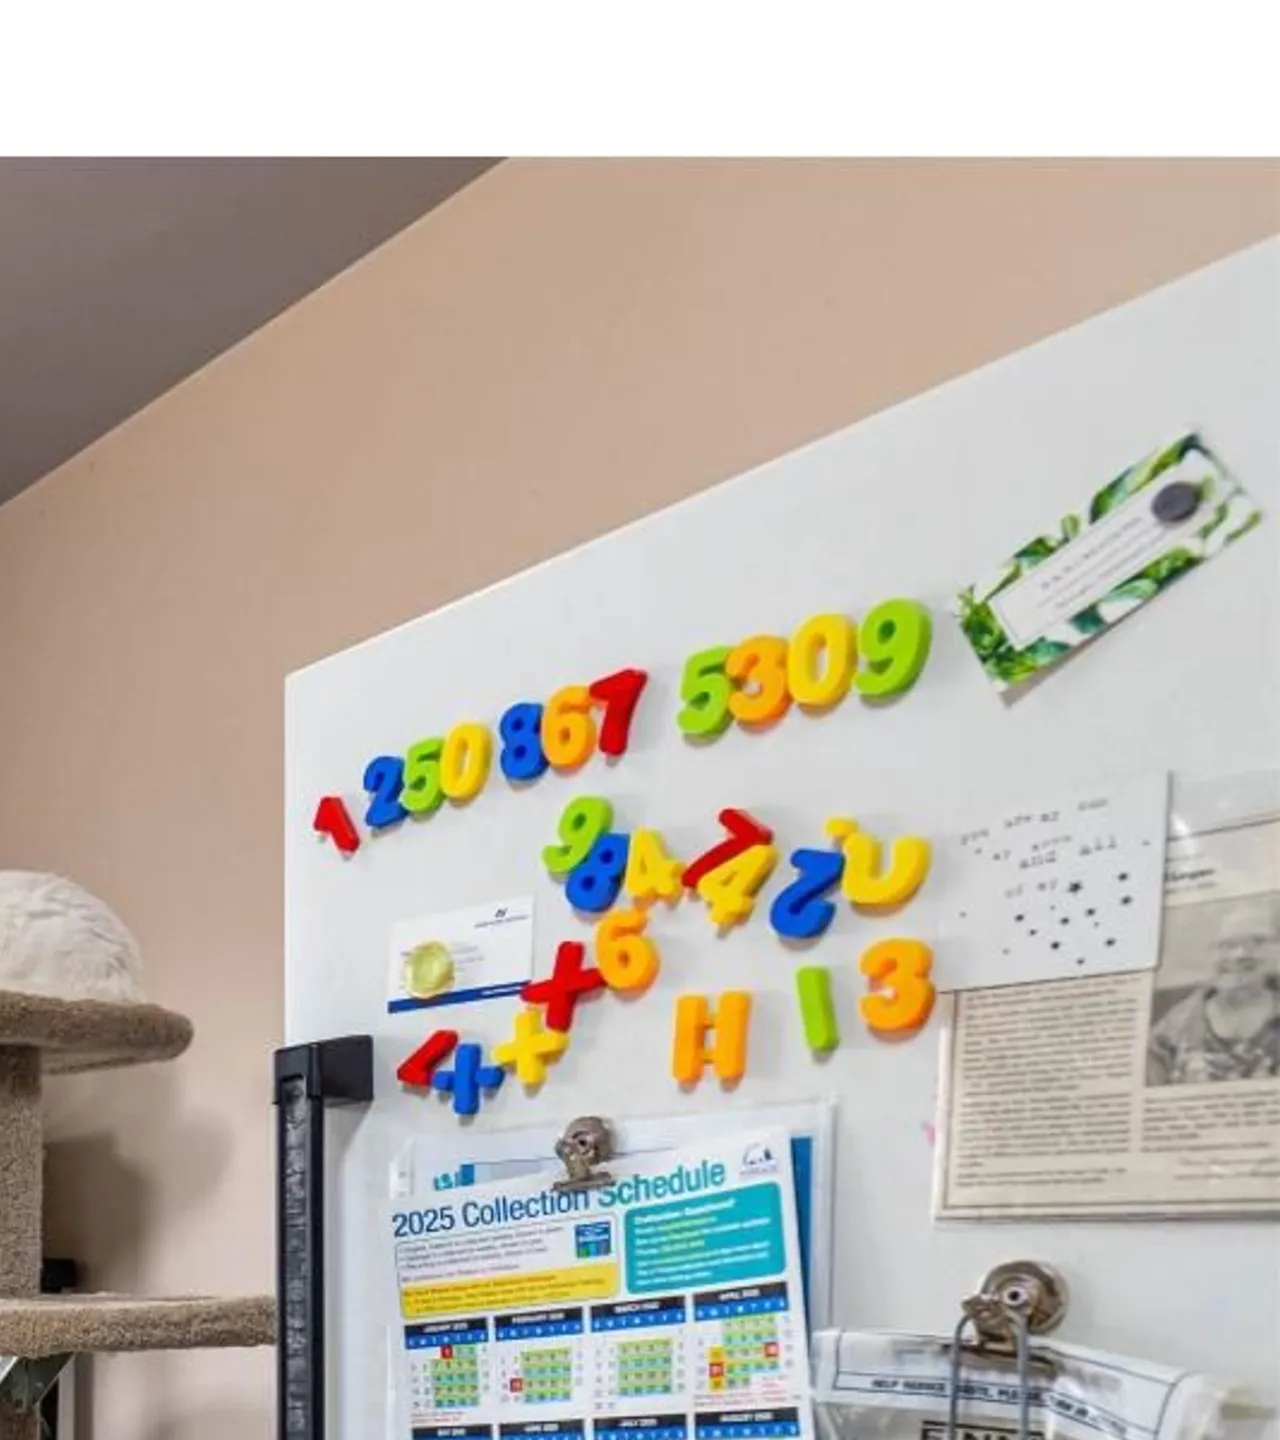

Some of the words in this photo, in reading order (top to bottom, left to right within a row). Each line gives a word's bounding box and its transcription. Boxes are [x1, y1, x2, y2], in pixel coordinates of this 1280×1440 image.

[363, 722, 492, 829] 250
[498, 668, 648, 782] 867
[677, 598, 932, 737] 5309
[392, 1208, 456, 1238] 2025
[461, 1187, 589, 1224] Collection
[598, 1159, 727, 1206] Schedule
